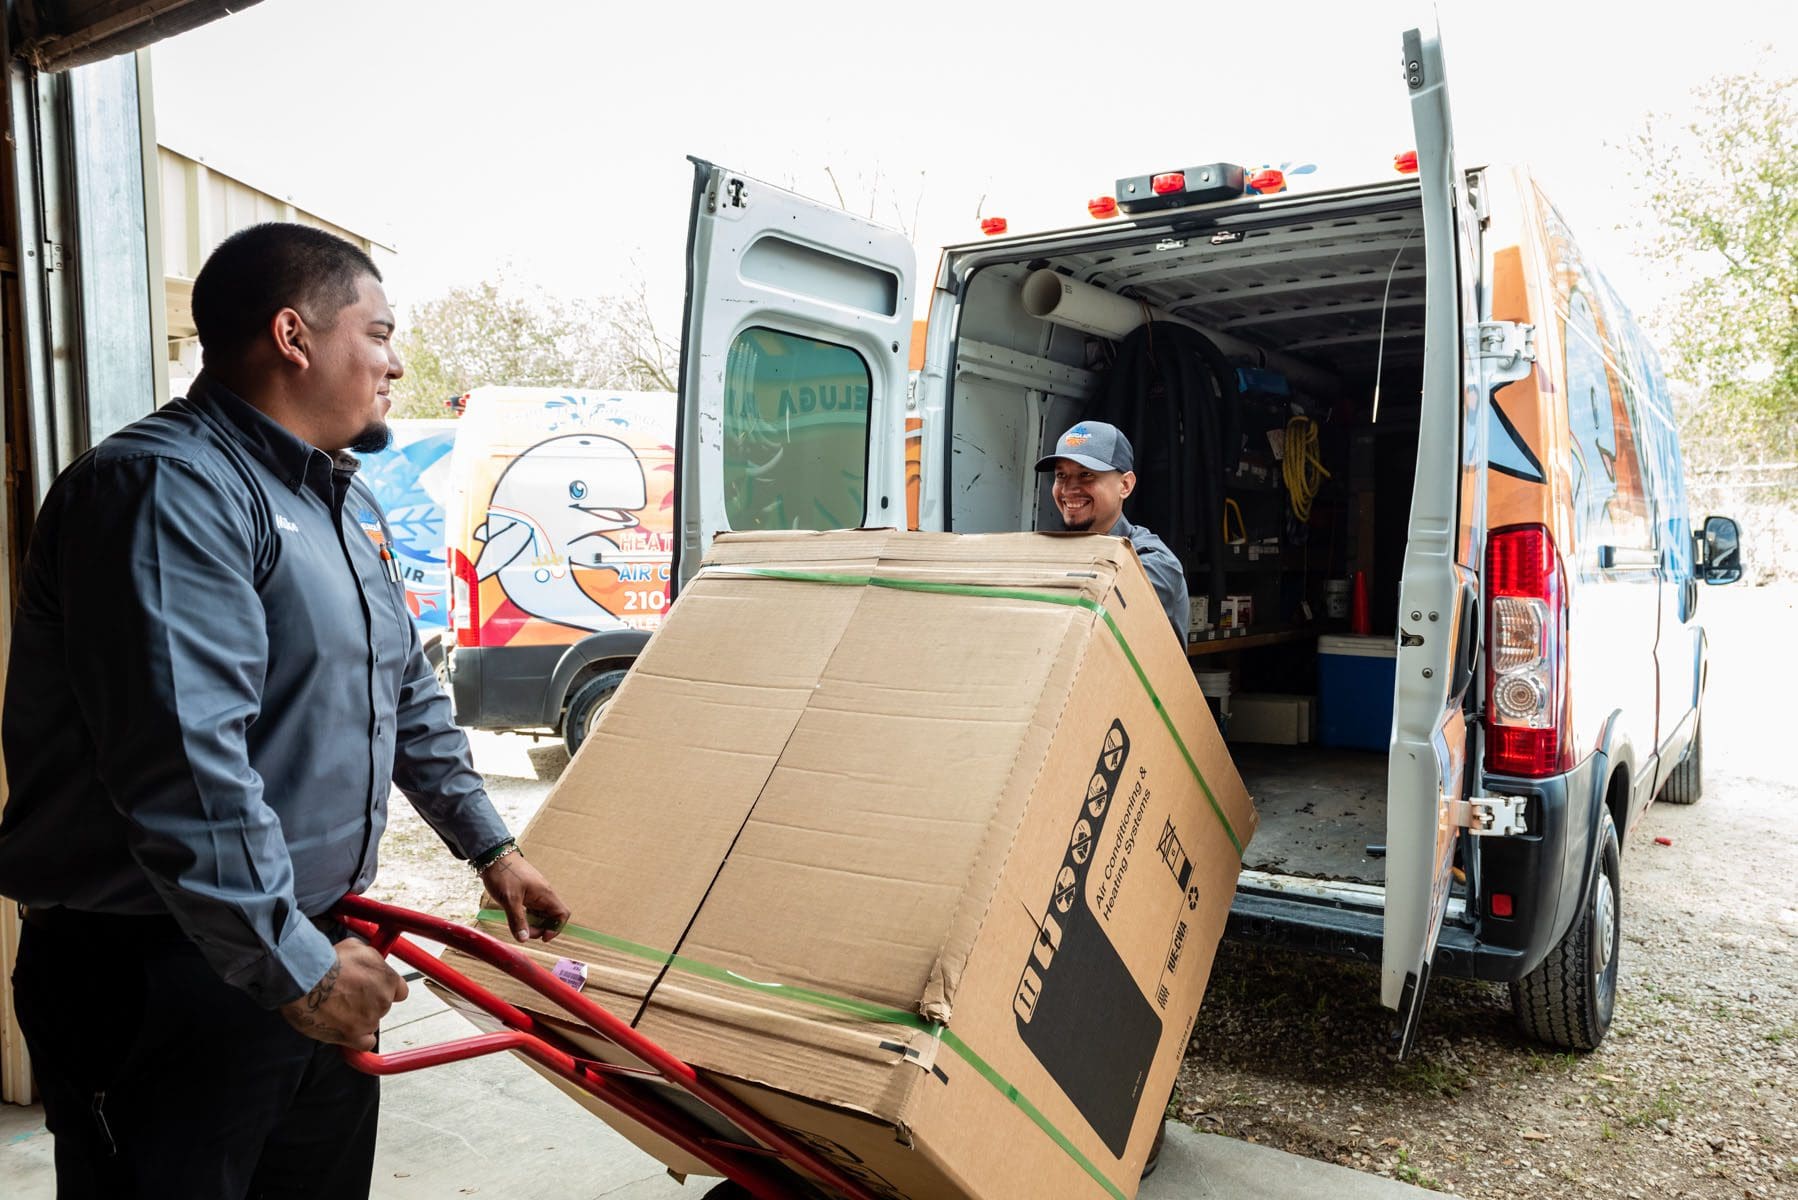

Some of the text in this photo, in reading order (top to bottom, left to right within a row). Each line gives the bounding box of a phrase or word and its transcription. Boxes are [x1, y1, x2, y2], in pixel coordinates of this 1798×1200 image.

[399, 562, 425, 583] IR
[619, 564, 651, 581] AIR
[1096, 766, 1147, 910] Air Conditioning &
[1103, 788, 1151, 921] Heating Systems
[1167, 920, 1188, 974] IUE-CWA
